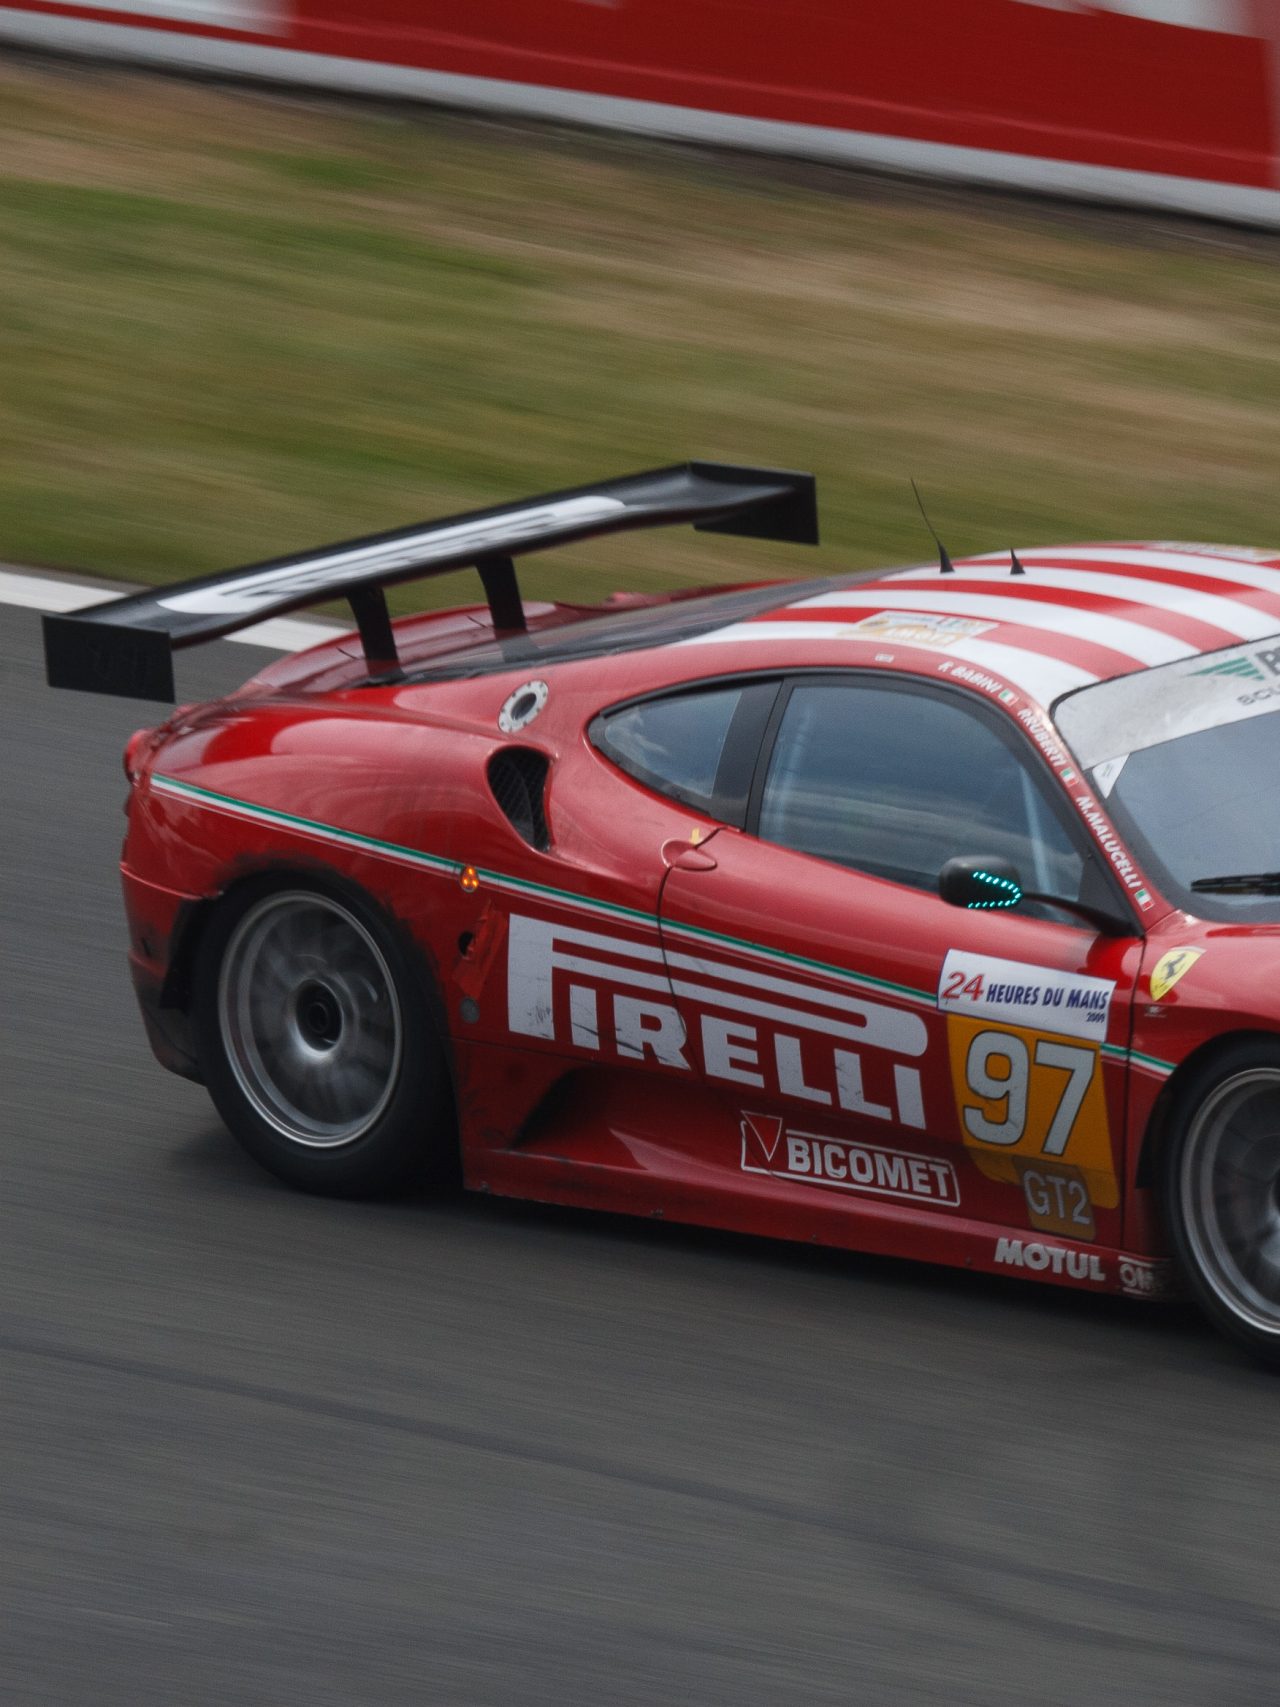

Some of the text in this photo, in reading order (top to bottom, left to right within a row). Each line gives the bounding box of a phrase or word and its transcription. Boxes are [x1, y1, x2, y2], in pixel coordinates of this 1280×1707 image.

[941, 971, 1110, 1010] 24 HEURES DU MANS
[507, 913, 928, 1130] PIRELLI
[962, 1029, 1096, 1158] 97
[786, 1137, 951, 1199] BICOMET
[1022, 1169, 1091, 1226] GT2
[994, 1237, 1106, 1281] MOTUL
